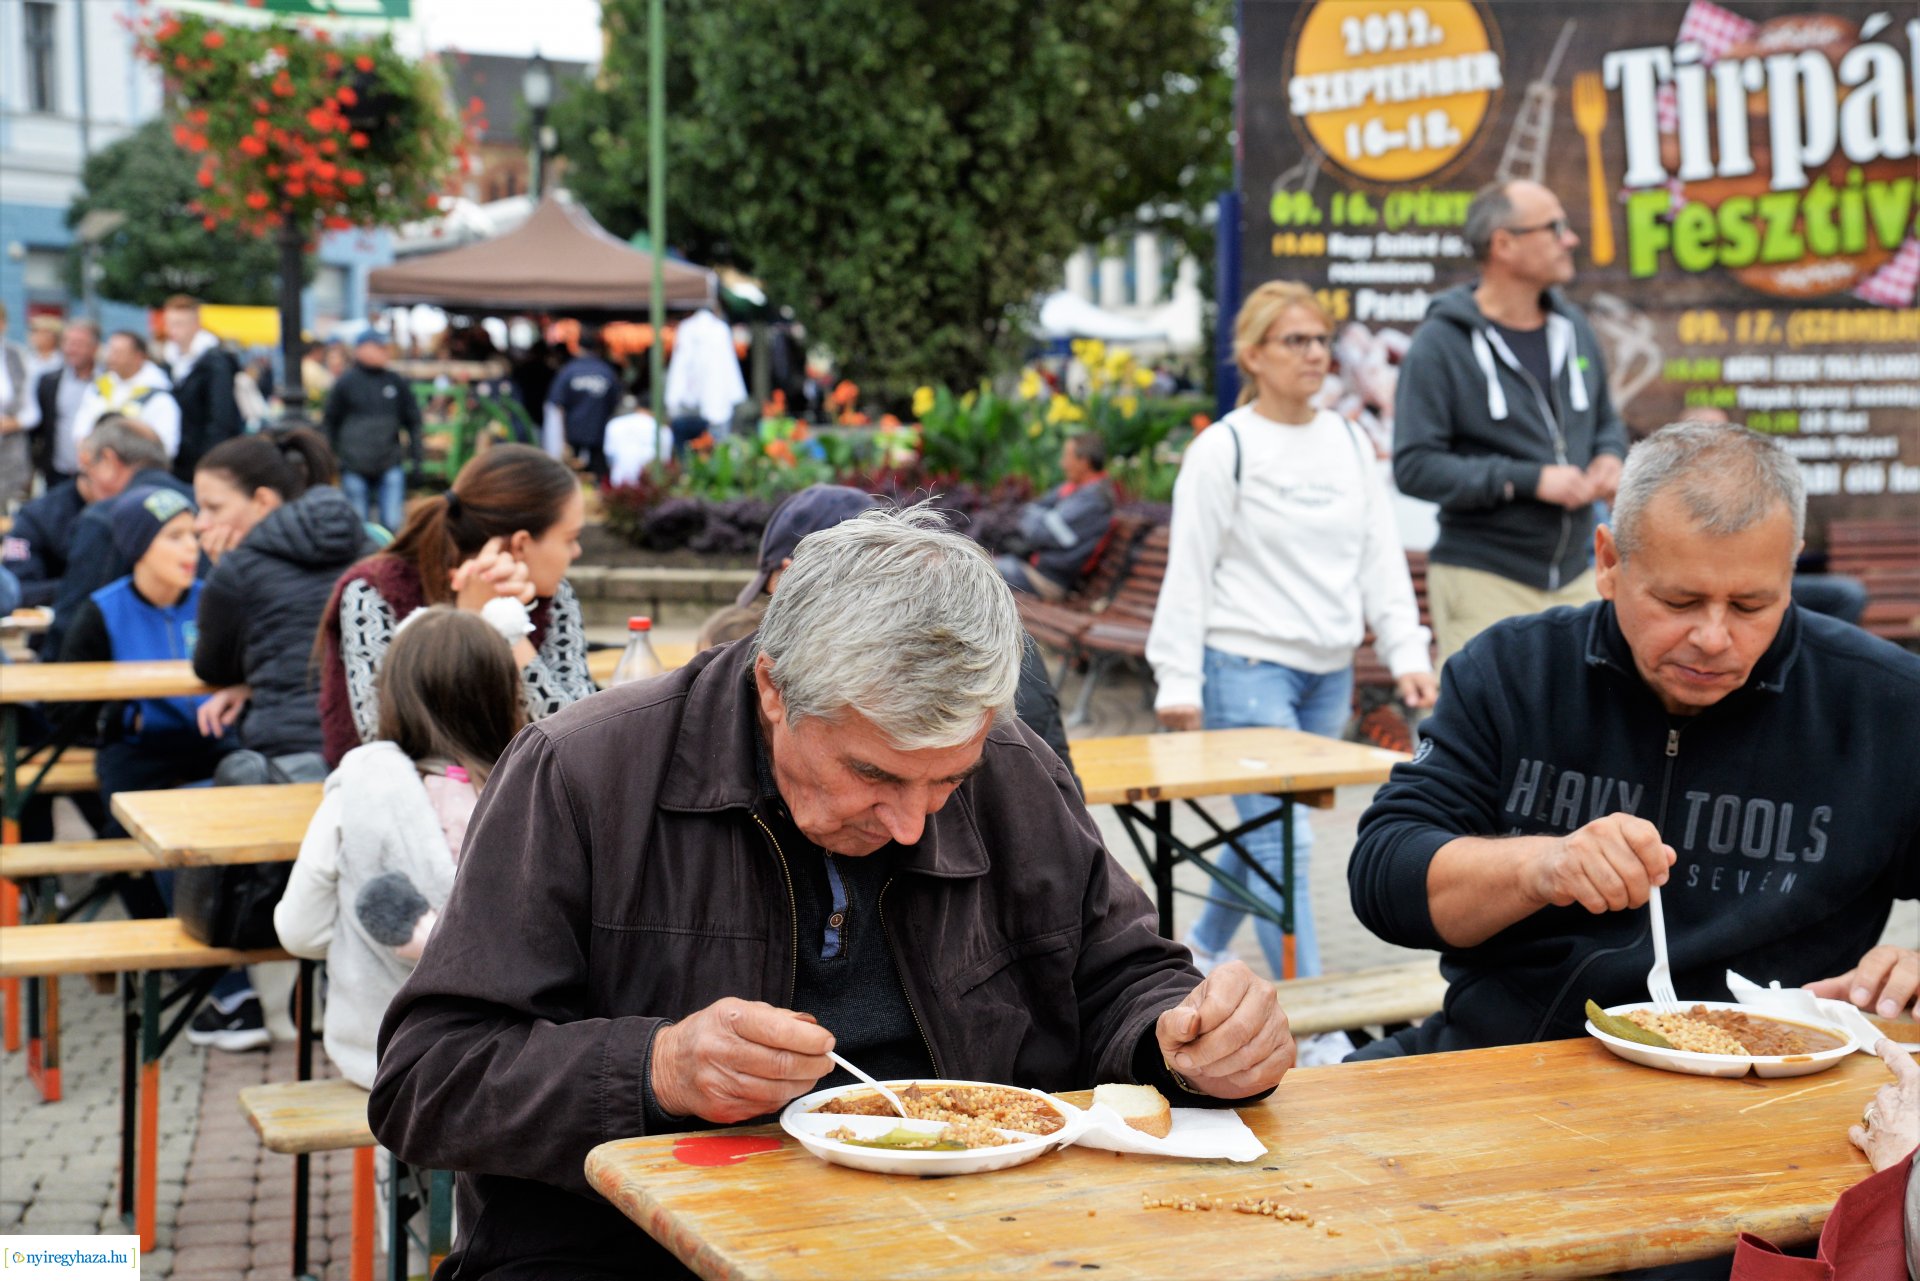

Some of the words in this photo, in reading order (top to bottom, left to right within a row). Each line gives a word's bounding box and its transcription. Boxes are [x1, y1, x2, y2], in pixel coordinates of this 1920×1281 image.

[1341, 7, 1444, 56] 2022.
[1288, 50, 1503, 116] SZEPTEMBER
[1603, 10, 1920, 191] Tirpá
[1270, 189, 1322, 226] 09.
[1330, 189, 1378, 226] 16.
[1383, 184, 1475, 231] (PÉNT
[1627, 167, 1920, 278] Fesztiv
[1678, 309, 1729, 344] 09.
[1735, 309, 1783, 344] 17.
[1504, 758, 1645, 829] HEAVY
[1683, 790, 1832, 863] TOOLS
[1686, 863, 1798, 895] SEVEN
